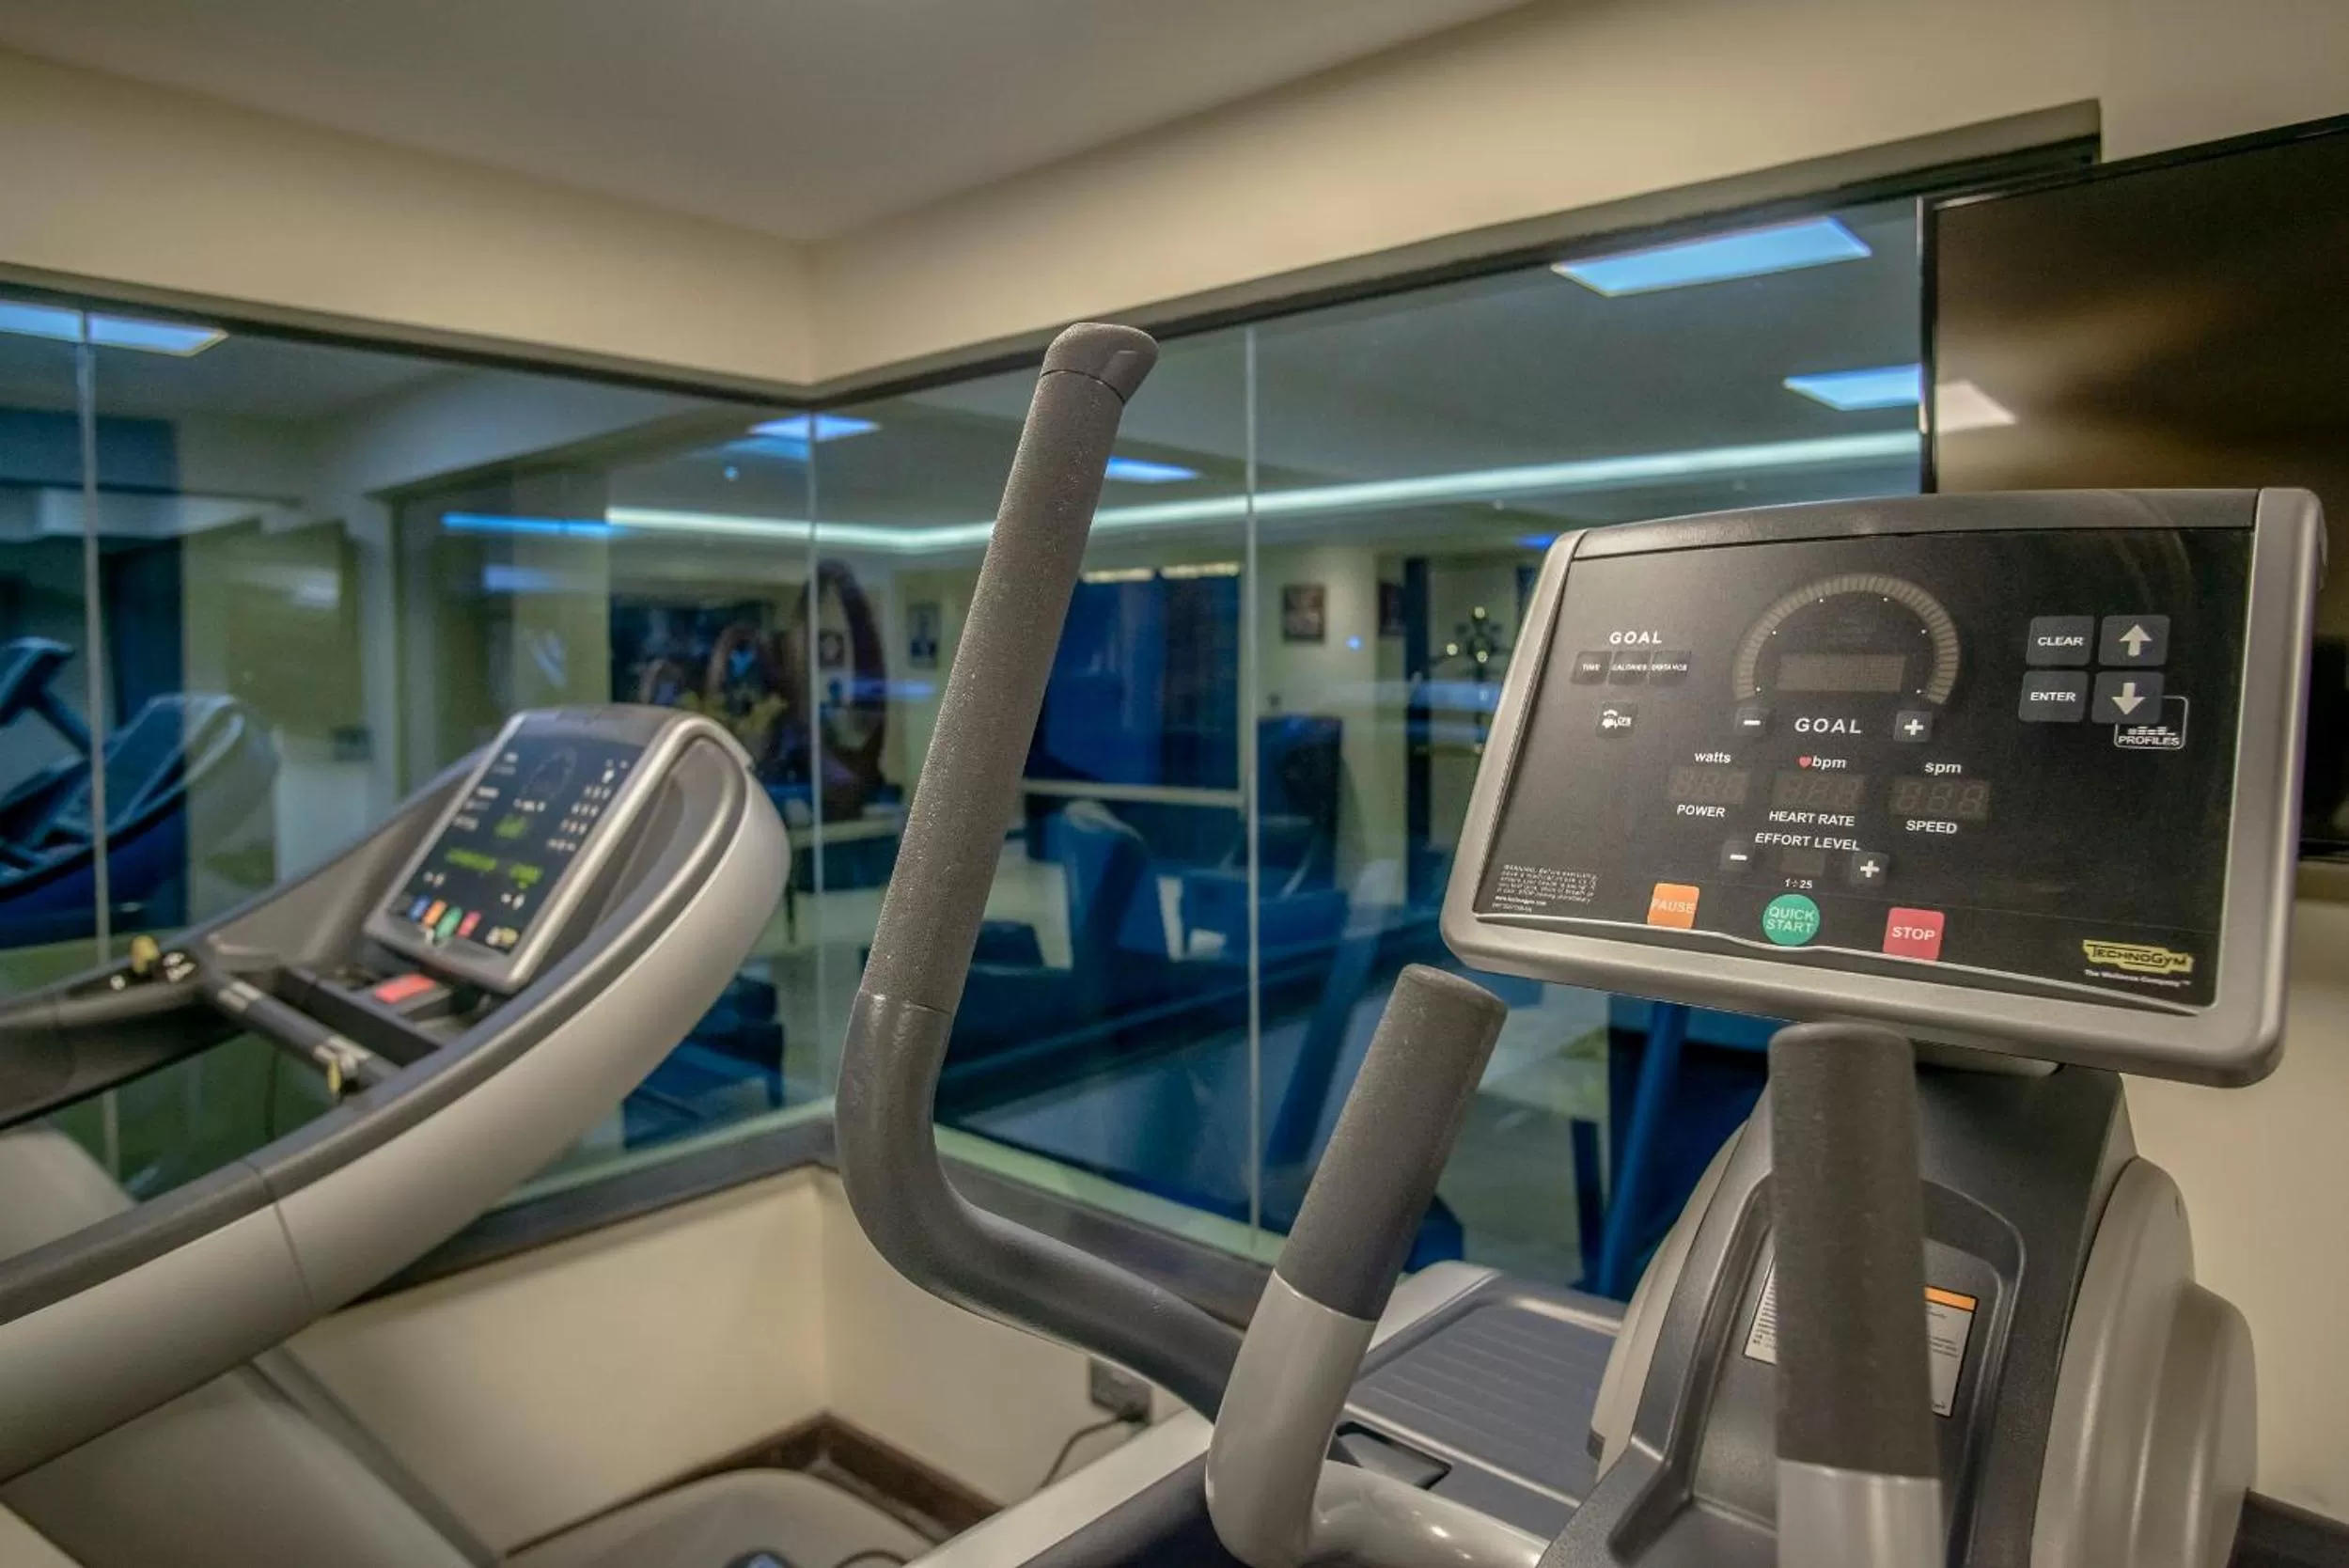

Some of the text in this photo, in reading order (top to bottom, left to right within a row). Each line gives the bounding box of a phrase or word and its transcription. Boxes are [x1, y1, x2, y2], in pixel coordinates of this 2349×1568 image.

[1609, 630, 1662, 645] GOAL
[2037, 635, 2084, 647] CLEAR
[2030, 691, 2076, 702] ENTER
[1794, 717, 1862, 734] GOAL
[2118, 735, 2180, 746] PROFILES
[1694, 751, 1731, 764] watts
[1812, 755, 1847, 770] bpm
[1924, 760, 1962, 776] spm
[1676, 804, 1726, 818] POWER
[1769, 809, 1856, 827] HEART RATE
[1905, 820, 1958, 835] SPEED
[1755, 833, 1861, 852] EFFORT LEVEL
[1652, 898, 1696, 915] PAUSE
[1769, 906, 1815, 922] QUICK
[1766, 918, 1813, 933] START
[1891, 926, 1935, 941] STOP
